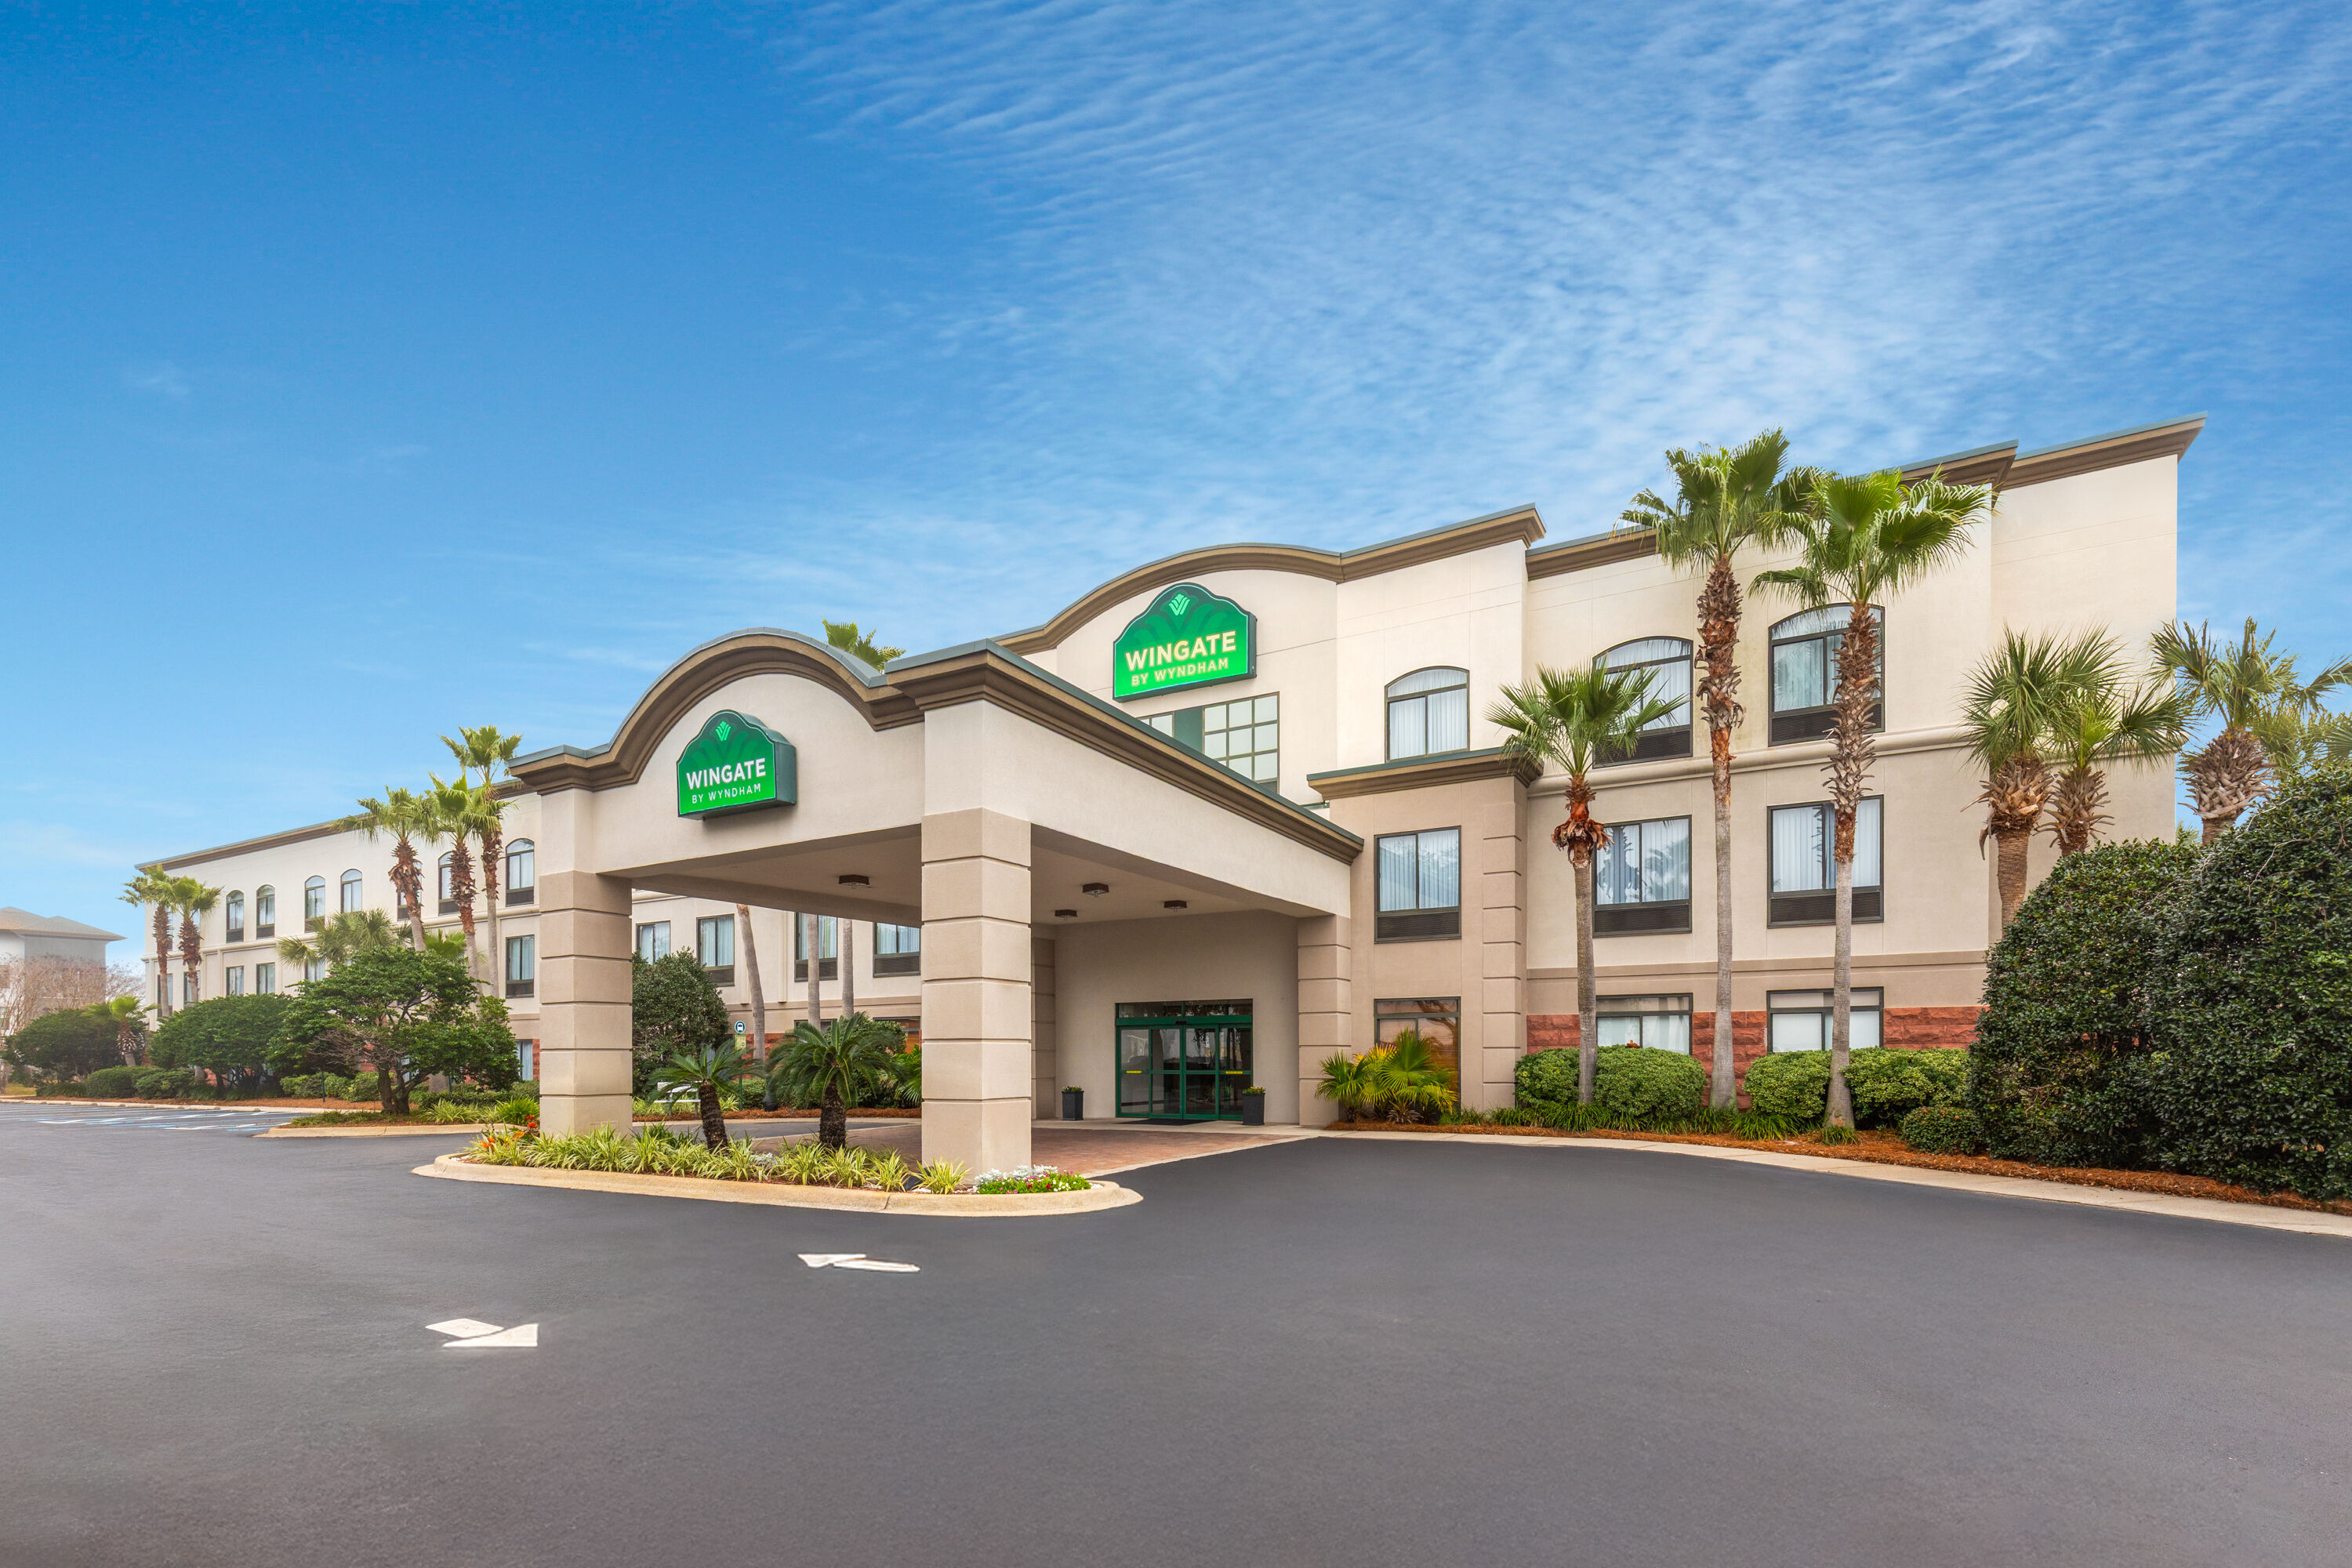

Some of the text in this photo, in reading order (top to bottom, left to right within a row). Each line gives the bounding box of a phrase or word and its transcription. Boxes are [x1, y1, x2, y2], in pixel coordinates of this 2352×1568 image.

[1125, 630, 1236, 670] WINGATE
[1131, 657, 1229, 687] BY WYNDHAM
[686, 757, 766, 789] WINGATE
[691, 783, 761, 804] BY WYNDHAM
